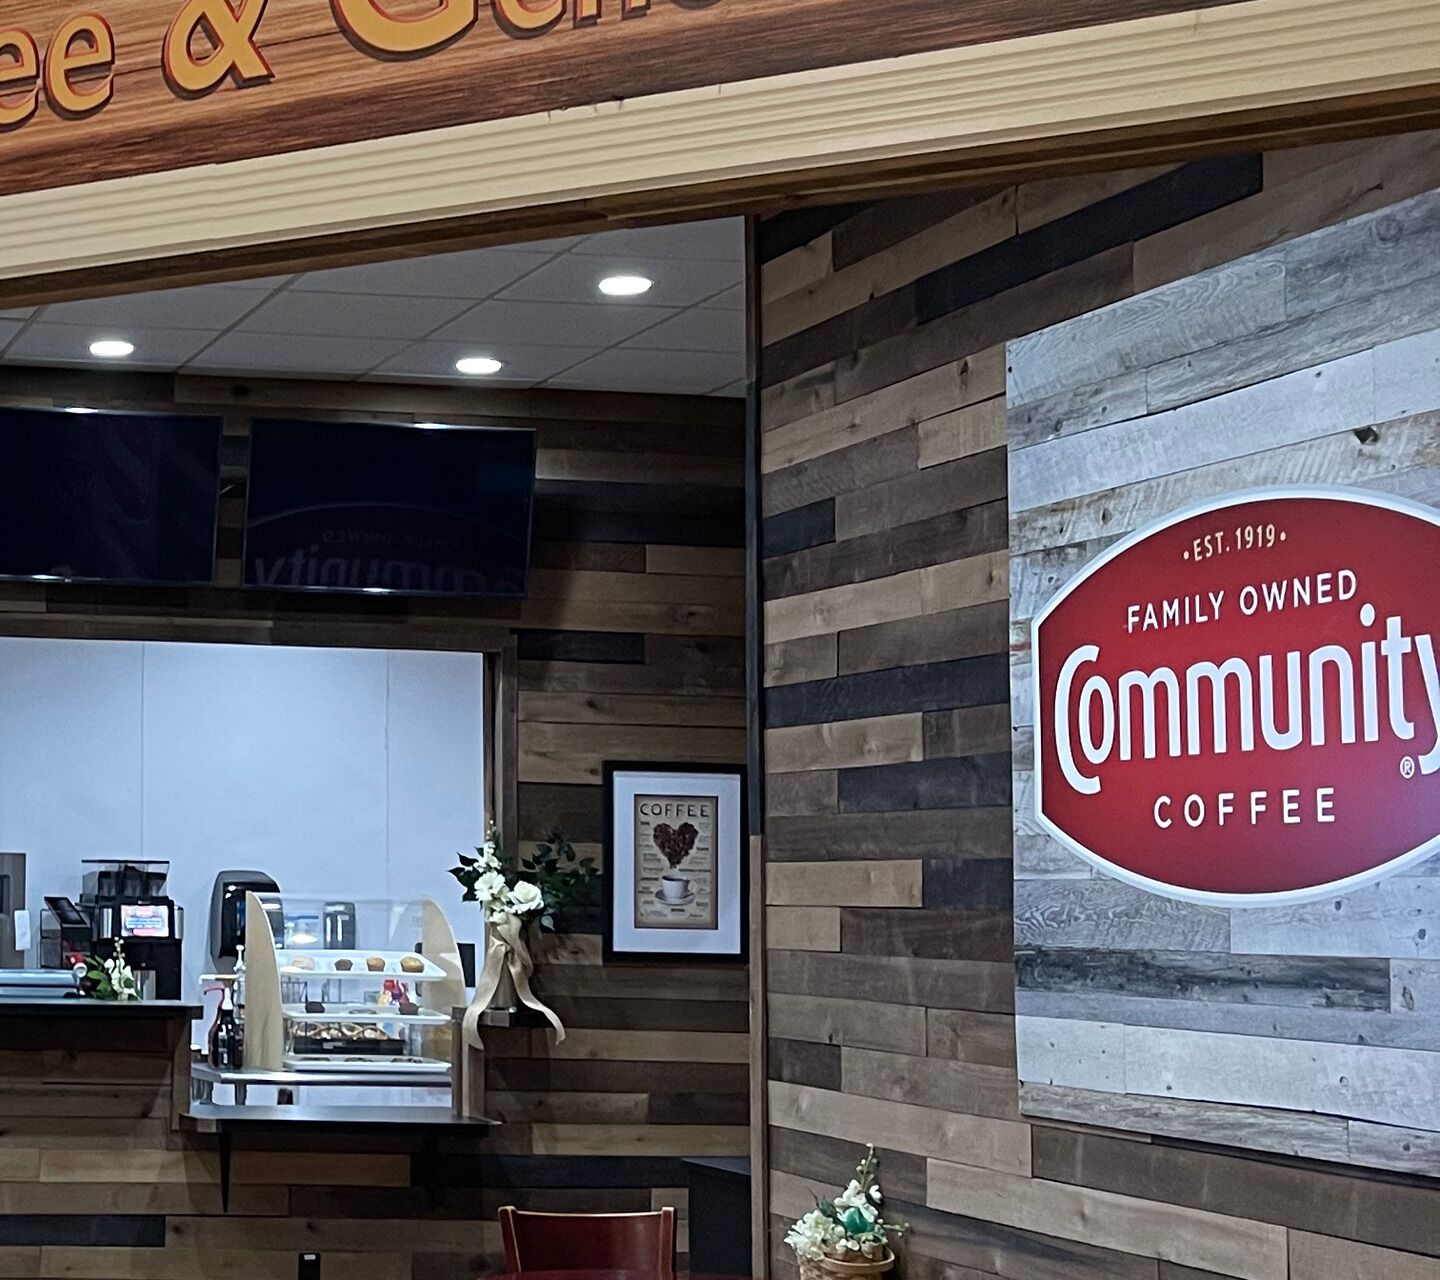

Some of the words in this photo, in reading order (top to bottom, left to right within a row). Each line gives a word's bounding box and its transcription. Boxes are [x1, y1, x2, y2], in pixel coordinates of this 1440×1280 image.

[1192, 532, 1230, 561] EST.
[1235, 524, 1276, 552] 1919
[1127, 591, 1224, 633] FAMILY
[1239, 569, 1356, 616] OWNED
[1054, 603, 1440, 794] Community
[640, 803, 709, 818] COFFEE
[1154, 787, 1335, 828] COFFEE
